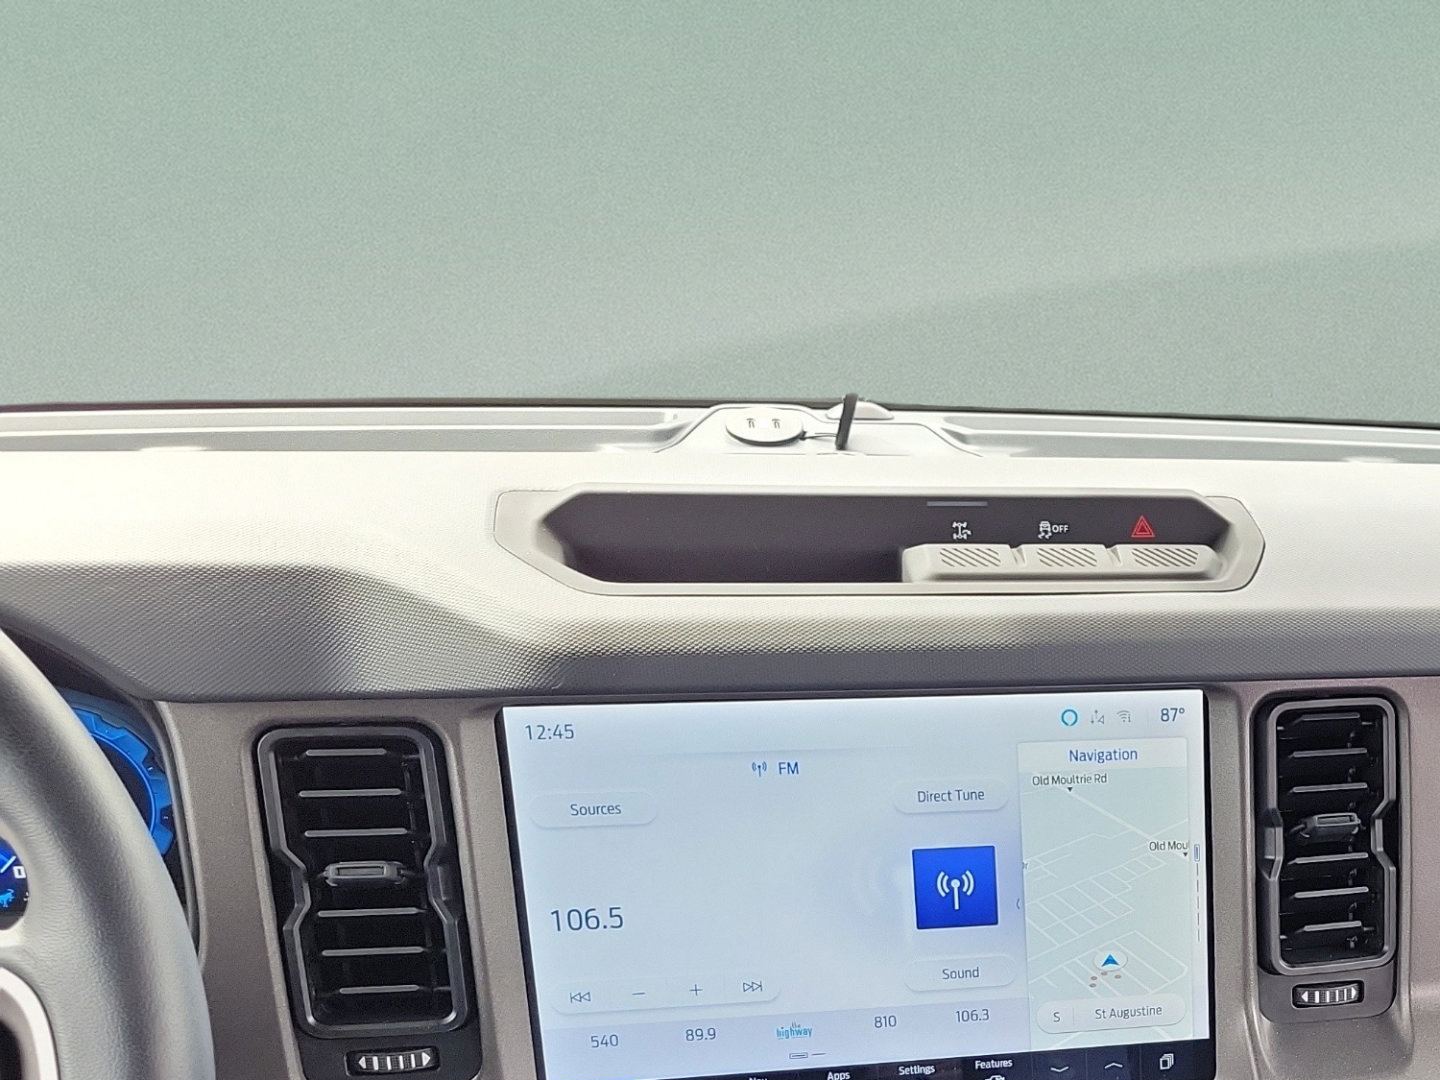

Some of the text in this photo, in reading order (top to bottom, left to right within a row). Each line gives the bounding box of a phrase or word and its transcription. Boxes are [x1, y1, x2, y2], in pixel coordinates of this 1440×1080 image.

[1052, 524, 1068, 533] OFF
[1160, 707, 1185, 723] 87°
[524, 724, 575, 741] 12:45
[1069, 748, 1138, 763] Navigation
[777, 762, 800, 776] FM
[1032, 773, 1107, 786] Old Moultrie Rd
[917, 789, 985, 804] Direct Tune
[570, 803, 622, 816] Sources
[1149, 841, 1166, 851] Old
[550, 906, 624, 932] 106.5
[942, 967, 979, 980] Sound
[956, 1009, 990, 1023] 106.3
[1053, 1011, 1061, 1023] S
[1095, 1005, 1163, 1020] St Augustine
[874, 1015, 897, 1029] 810
[685, 1027, 716, 1042] 89.9
[776, 1026, 813, 1040] highway
[590, 1035, 619, 1048] 540
[899, 1064, 935, 1076] Settings
[975, 1058, 1013, 1070] Features
